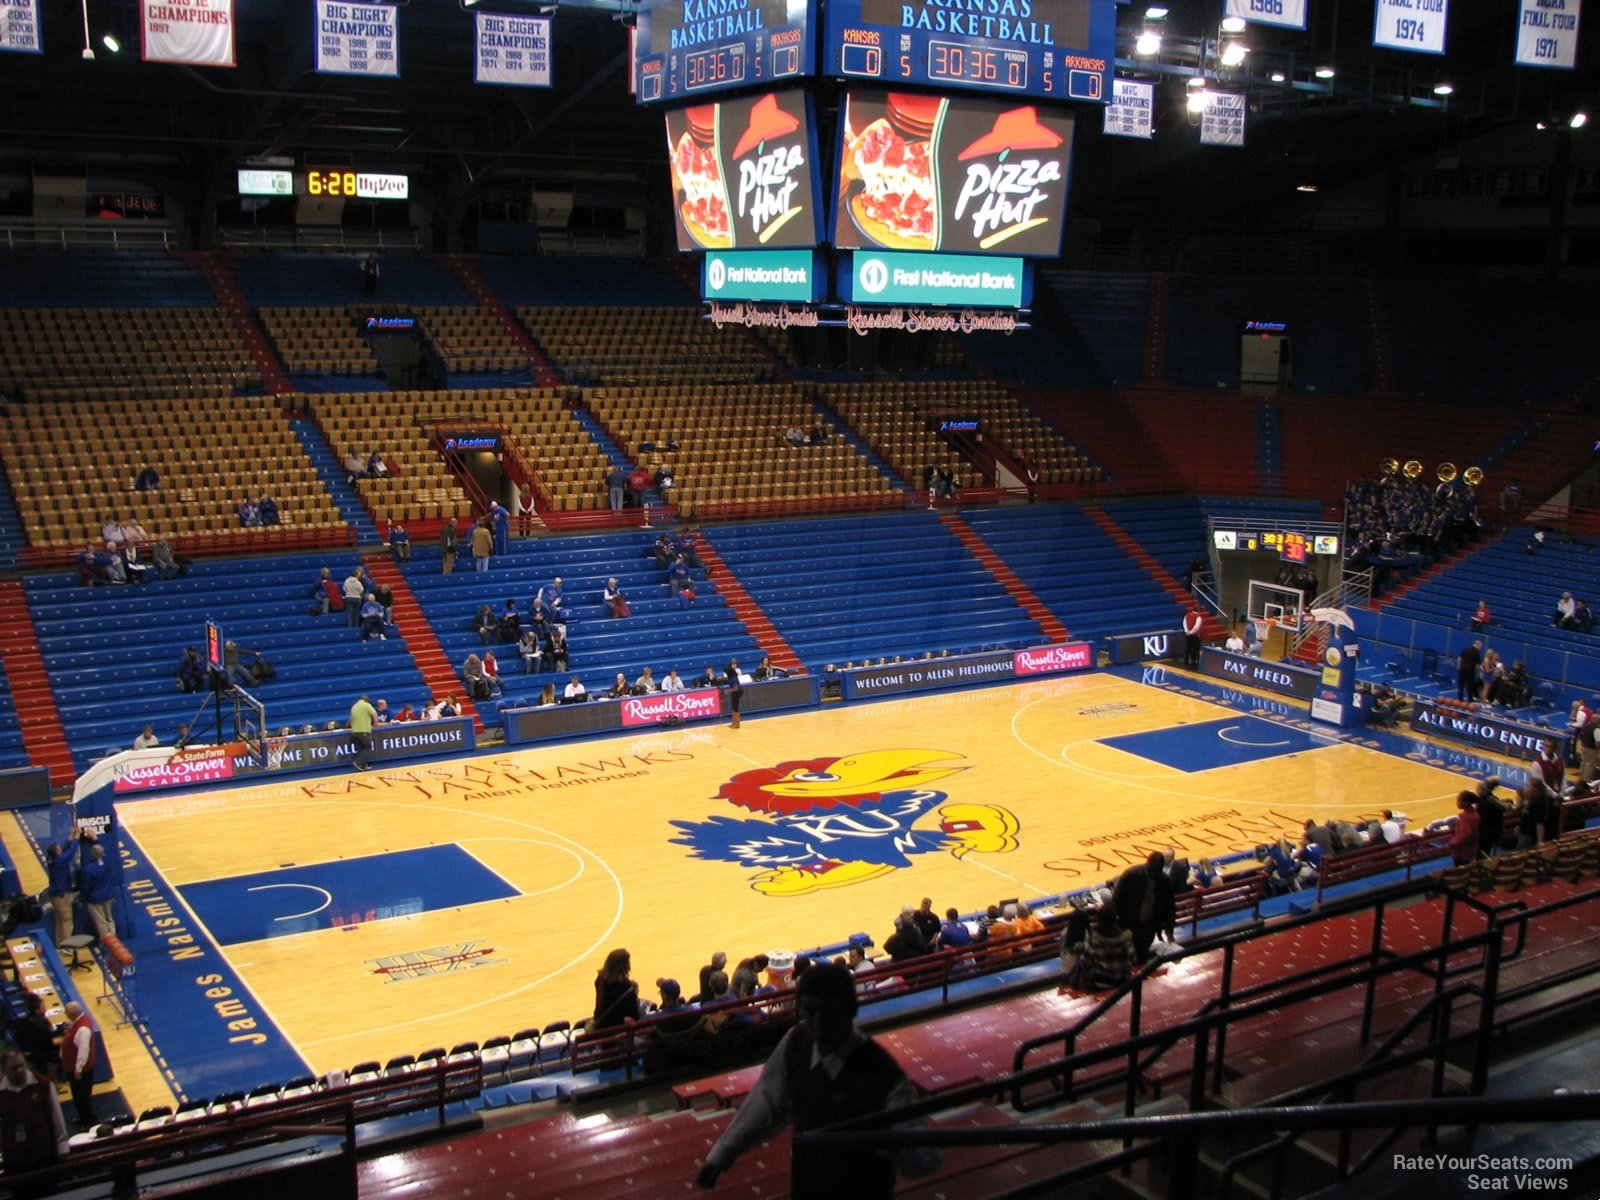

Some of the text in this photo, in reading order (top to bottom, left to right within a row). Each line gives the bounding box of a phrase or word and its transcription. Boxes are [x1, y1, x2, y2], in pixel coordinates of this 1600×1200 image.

[149, 5, 228, 25] CHAMPIONS
[327, 5, 388, 22] BIG EIGHT
[926, 0, 1031, 18] NSAS
[1250, 0, 1283, 15] 1986
[1416, 0, 1443, 12] FOUR
[150, 22, 170, 33] 1997
[322, 19, 393, 37] CHAMPIONS
[485, 19, 541, 35] BIG EIGHT
[671, 9, 763, 49] BASKETBALL
[902, 5, 1054, 45] BASKETBALL
[1396, 18, 1424, 41] 1974
[1523, 10, 1575, 30] FINAL FOUR
[481, 33, 546, 49] CHAMPIONS
[844, 29, 880, 45] KANSAS
[1004, 52, 1025, 62] PERIOD
[1535, 38, 1558, 58] 1971
[689, 53, 726, 84] 30:36
[732, 56, 740, 79] 0
[755, 57, 762, 77] 5
[788, 49, 796, 72] 0
[866, 50, 878, 74] 0
[900, 56, 911, 76] 5
[936, 47, 996, 80] 30:36
[1065, 55, 1105, 71] ARKANSAS
[670, 75, 677, 93] 5
[1008, 62, 1019, 85] 0
[1043, 72, 1053, 91] 5
[653, 75, 660, 96] 0
[1089, 75, 1100, 97] 0
[1112, 95, 1149, 109] HAMPIONS
[308, 171, 356, 196] 6:28
[739, 140, 804, 217] Pizza
[955, 148, 1061, 221] Pizza
[750, 176, 799, 233] Hut
[972, 188, 1048, 238] Hut
[727, 266, 744, 282] First
[745, 266, 780, 283] National
[783, 267, 807, 283] Bank
[893, 269, 919, 286] First
[922, 270, 980, 288] National
[981, 273, 1015, 289] Bank
[378, 317, 415, 327] Academy
[711, 301, 818, 330] Russell Stover Candies
[845, 303, 1016, 336] Russell Stover Candies
[457, 438, 497, 449] Academy
[1263, 532, 1283, 544] 30:3
[1143, 634, 1168, 656] KU
[1017, 647, 1085, 669] Russell Stover
[1040, 661, 1083, 672] CANDIES
[855, 660, 1014, 689] WELCOME TO ALLEN FIELDHOUSE
[1223, 660, 1293, 688] PAY HEED.
[624, 692, 715, 720] Russell Stover
[655, 708, 711, 721] CDIES
[1452, 718, 1495, 739] WHO
[1500, 730, 1546, 752] ENTE
[184, 748, 226, 764] State Farm
[234, 730, 462, 768] WEOME TO ALL FIELDHOUSE
[149, 771, 220, 787] CANDIES
[301, 758, 521, 799] KANSAS
[414, 748, 696, 800] JAYHAWKS
[463, 768, 651, 802] Allen Fieldhouse
[77, 815, 111, 827] MUSCLE
[84, 825, 106, 836] LK
[787, 809, 900, 843] KU
[1078, 808, 1243, 848] Allen Fieldhouse
[1043, 809, 1306, 878] JAYHAWKS
[127, 879, 205, 961] Naismith
[196, 973, 268, 1046] James
